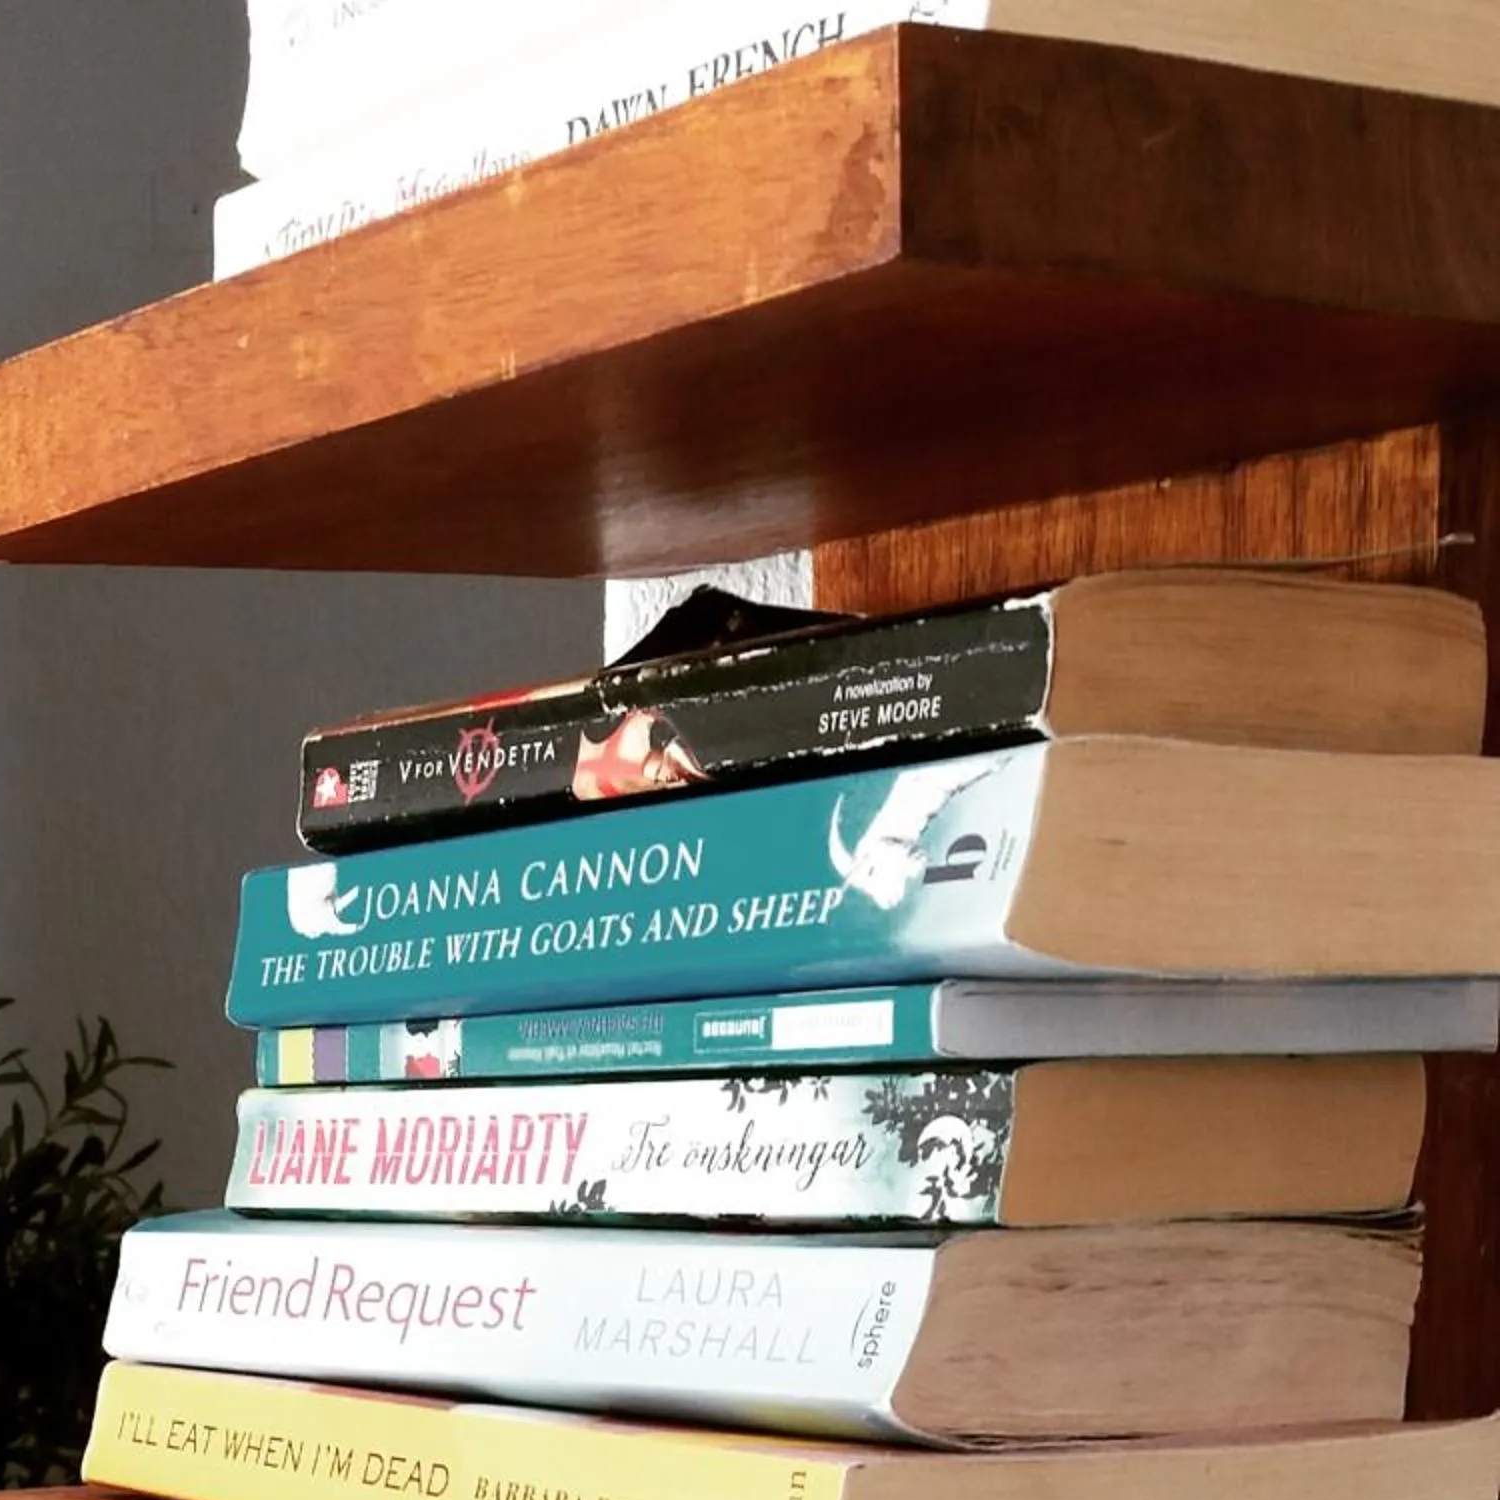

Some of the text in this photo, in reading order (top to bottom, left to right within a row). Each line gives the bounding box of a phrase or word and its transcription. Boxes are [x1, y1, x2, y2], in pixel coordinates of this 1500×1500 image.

[818, 696, 942, 734] STEVE MOORE
[834, 685, 843, 702] A
[917, 672, 933, 692] by
[400, 761, 413, 784] V
[449, 741, 556, 777] VENDETTA
[359, 838, 705, 930] JOANNA CANNON
[259, 887, 842, 988] THE TROUBLE WITH GOATS AND SHEEP
[248, 1111, 590, 1187] LIANE MORIARTY
[612, 1114, 674, 1173] Tre
[177, 1256, 321, 1320] Friend
[327, 1263, 537, 1346] Request
[635, 1265, 784, 1309] LAURA
[573, 1315, 817, 1365] MARSHALL
[856, 1279, 898, 1371] sphere
[117, 1410, 451, 1500] I'LL EAT WHEN I'M DEAD
